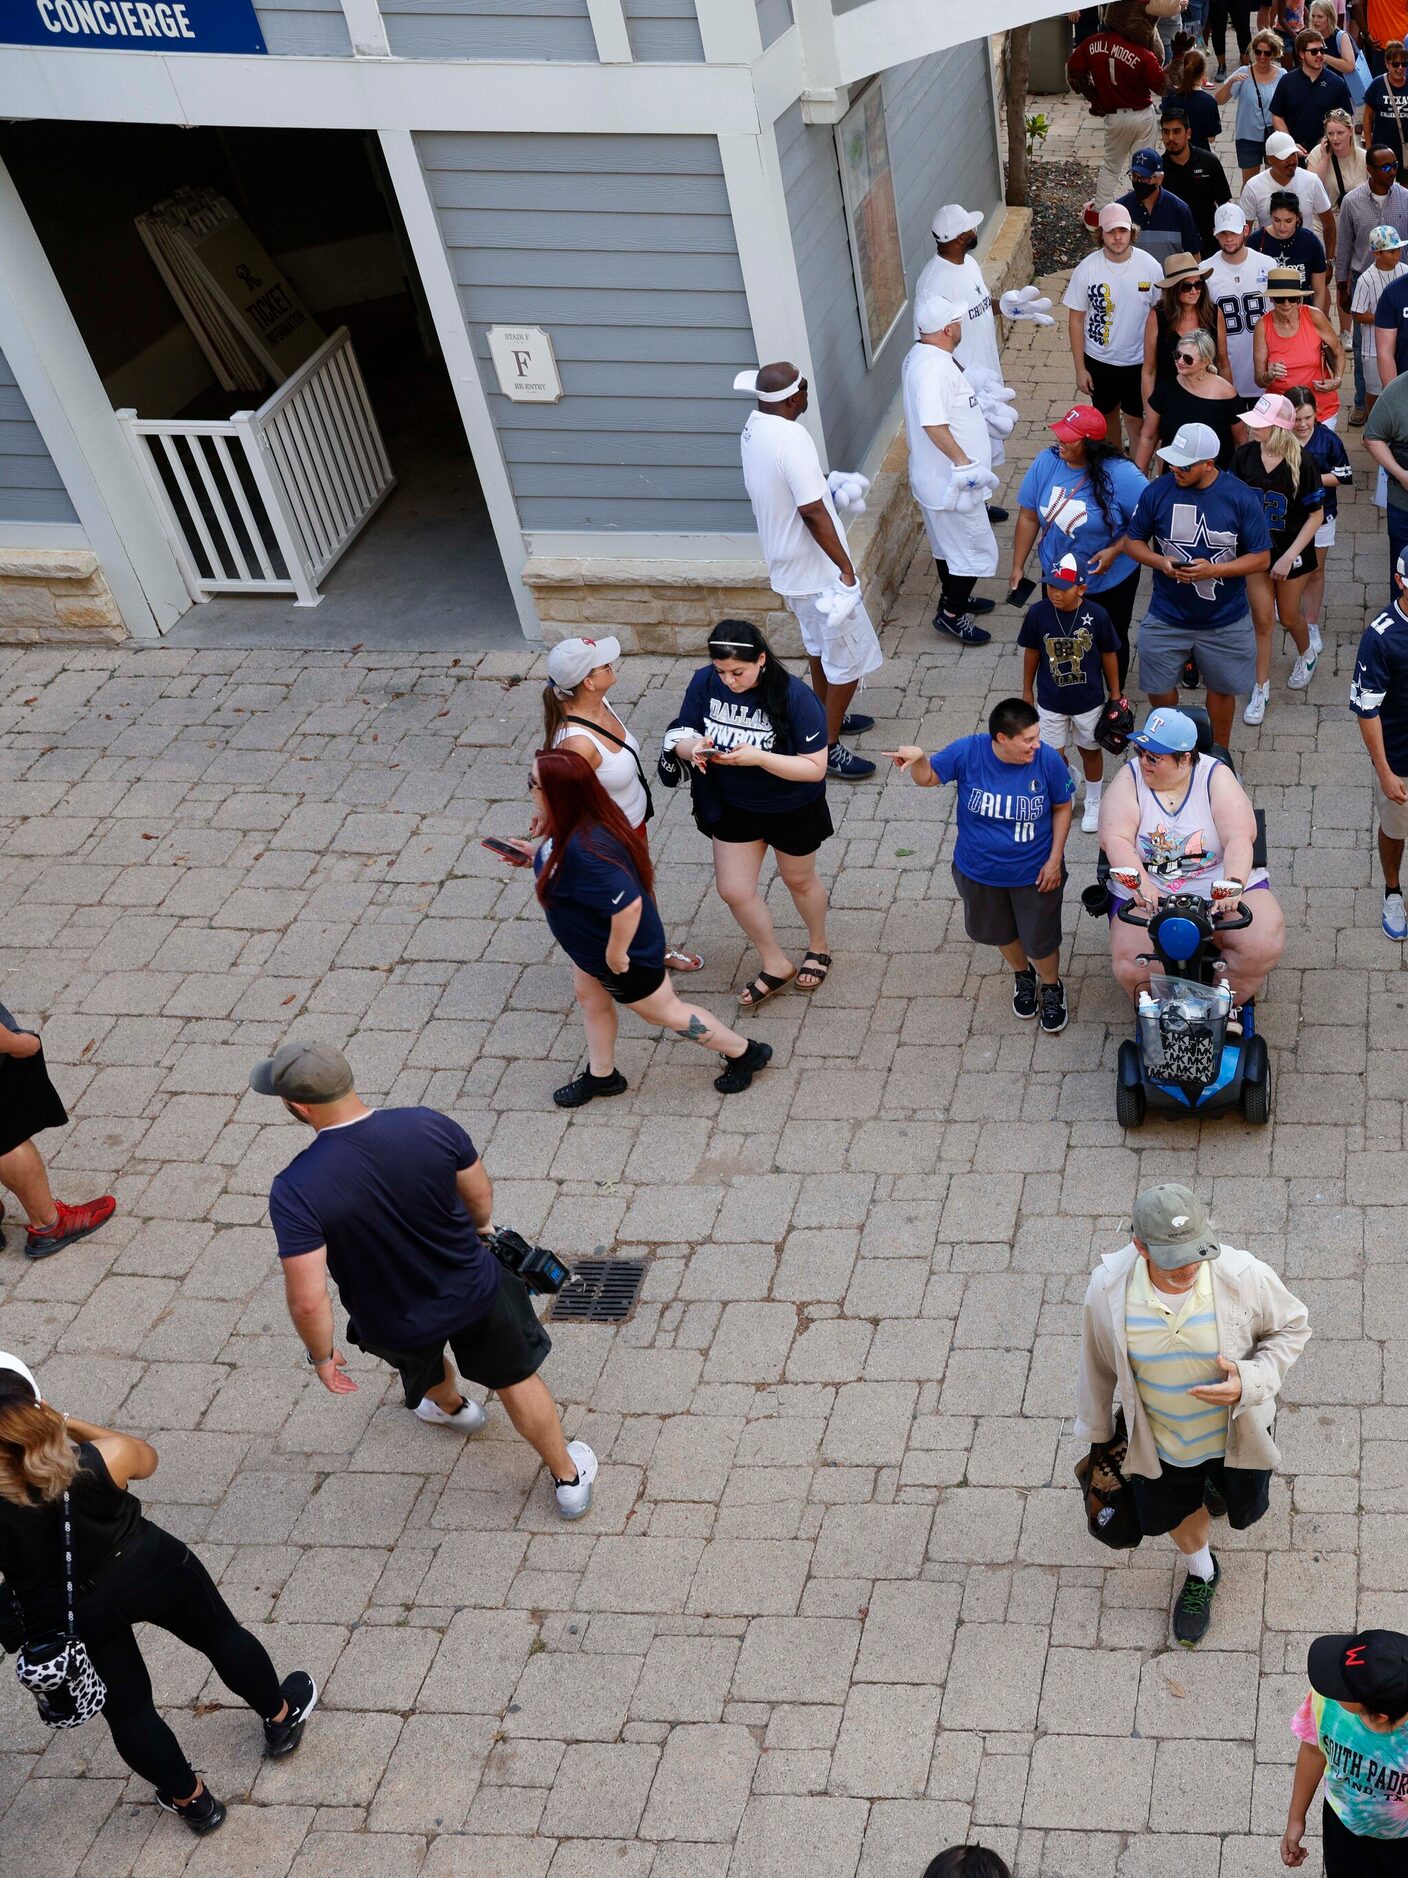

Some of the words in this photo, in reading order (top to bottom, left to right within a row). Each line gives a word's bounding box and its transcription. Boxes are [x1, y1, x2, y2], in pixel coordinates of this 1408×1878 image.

[36, 0, 196, 38] CONCIERGE
[1089, 41, 1109, 55] BULL
[1111, 44, 1140, 69] MOOSE
[1108, 57, 1118, 85] 1
[244, 283, 294, 331] TICKET
[1216, 290, 1267, 336] 88
[511, 350, 533, 377] F
[1064, 410, 1079, 422] T
[1370, 612, 1395, 635] 11
[709, 697, 773, 732] DALLAS
[1150, 715, 1165, 734] T
[967, 788, 1045, 821] DALLAS
[1322, 1734, 1363, 1780] SOUTH
[1383, 1793, 1405, 1803] TX
